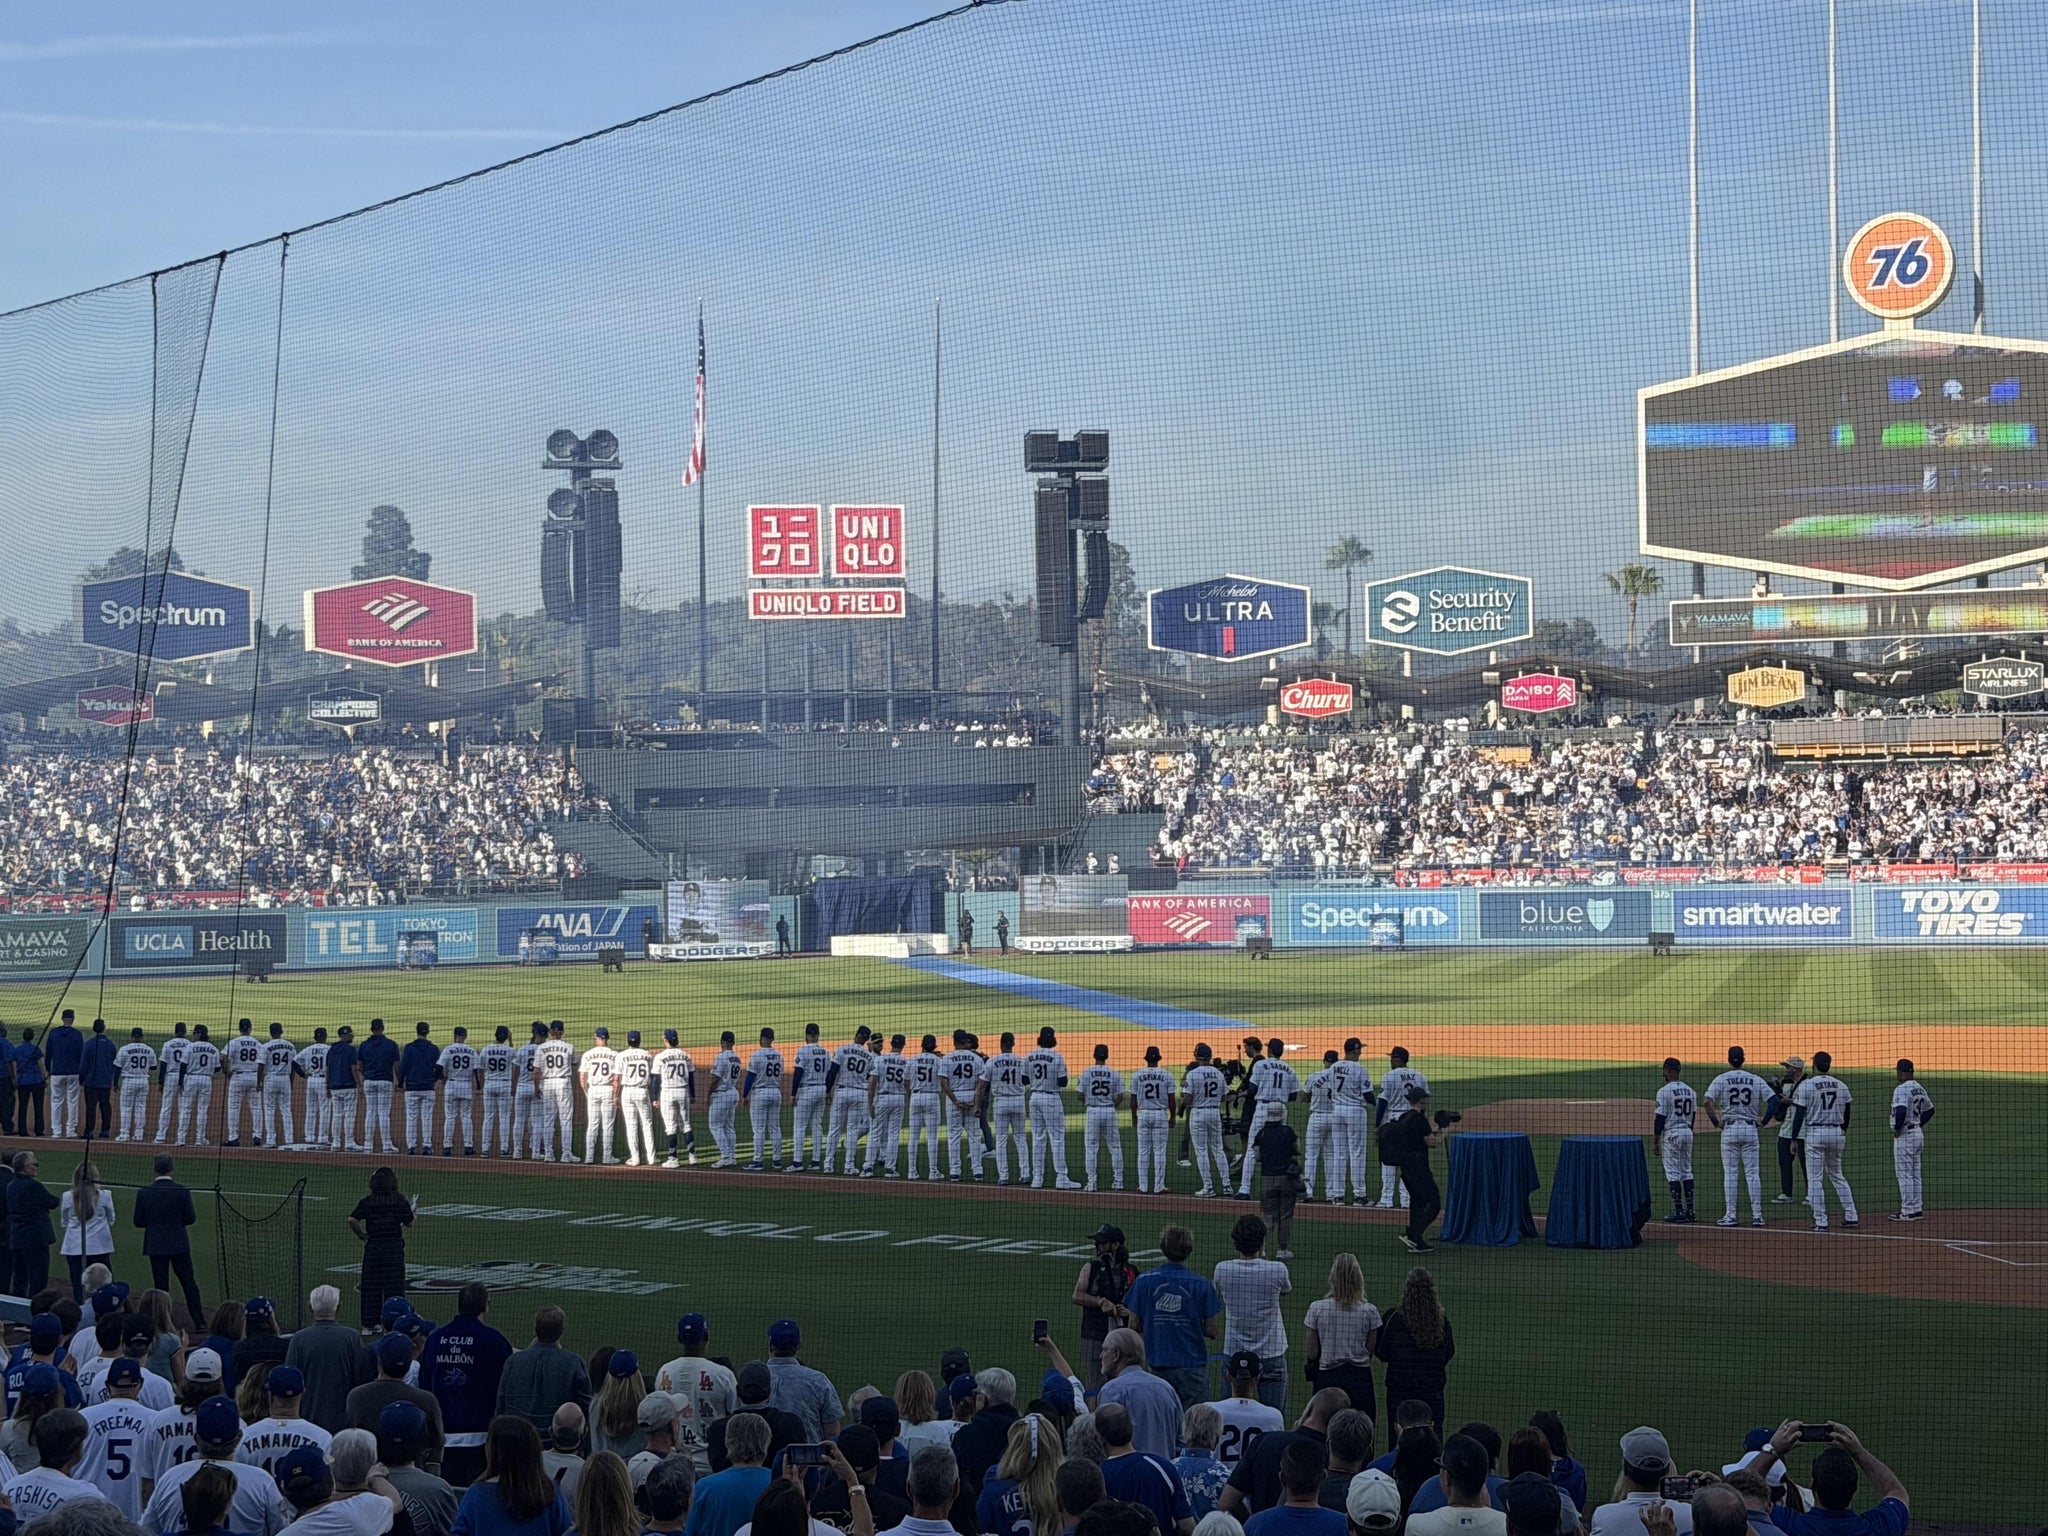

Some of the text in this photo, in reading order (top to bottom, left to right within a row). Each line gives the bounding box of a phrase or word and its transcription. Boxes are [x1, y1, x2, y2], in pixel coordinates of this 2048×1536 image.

[1868, 238, 1931, 289] 76
[842, 516, 890, 539] UNI
[843, 543, 895, 571] QLO
[759, 594, 897, 616] UNIQLO FIELD
[1429, 587, 1516, 612] Security
[99, 600, 226, 630] Spectrum
[1184, 601, 1275, 622] ULTRA
[347, 638, 443, 648] BANK OF AMERICA
[1968, 667, 2039, 679] STARLUX
[1506, 685, 1554, 696] DAISO
[1733, 671, 1798, 698] JIM BEAM
[1979, 679, 2030, 689] AIRLINES
[81, 699, 151, 712] Yakult
[311, 700, 379, 709] CHAMPIONS
[1283, 688, 1350, 709] Churu
[311, 709, 379, 718] COLLECTIVE
[1128, 897, 1161, 909] ANK
[1165, 898, 1183, 909] OF
[1186, 897, 1252, 909] AMERICA
[1654, 891, 1670, 899] 375
[1901, 889, 2001, 913] TOYO
[1301, 902, 1440, 934] Specm
[1520, 899, 1584, 924] blue
[1683, 903, 1842, 926] smartwater
[401, 917, 448, 931] TOKYO
[534, 913, 593, 937] ANA
[1917, 913, 2028, 936] TIRES
[134, 929, 273, 952] UCLA Health
[310, 919, 389, 955] TEL
[437, 931, 473, 943] TRON
[1030, 939, 1117, 949] DODGERS
[24, 947, 69, 958] CASINO
[581, 941, 592, 951] of
[593, 941, 625, 951] JAPAN
[675, 946, 761, 957] DODGERS
[130, 1055, 148, 1070] 90
[173, 1049, 182, 1063] 0
[199, 1053, 208, 1067] 0
[239, 1048, 258, 1062] 88
[272, 1051, 289, 1066] 84
[311, 1056, 324, 1071] 91
[452, 1055, 470, 1070] 89
[545, 1054, 564, 1069] 80
[488, 1057, 507, 1072] 96
[591, 1062, 611, 1077] 78
[628, 1063, 647, 1079] 76
[667, 1063, 687, 1079] 70
[765, 1062, 781, 1078] 66
[814, 1057, 826, 1074] 61
[847, 1056, 866, 1074] 60
[952, 1063, 973, 1079] 49
[1034, 1063, 1048, 1080] 31
[885, 1066, 904, 1084] 59
[917, 1066, 933, 1083] 51
[1001, 1068, 1017, 1085] 41
[1273, 1071, 1284, 1089] 11
[1726, 1077, 1755, 1086] TUCKER
[1090, 1079, 1111, 1097] 25
[1144, 1082, 1161, 1100] 21
[1204, 1081, 1218, 1098] 12
[1335, 1076, 1346, 1093] 7
[1672, 1088, 1691, 1097] BETTS
[1728, 1087, 1752, 1106] 23
[1820, 1091, 1837, 1111] 17
[1674, 1098, 1692, 1117] 50
[449, 1336, 475, 1345] CLUB
[450, 1345, 461, 1354] du
[9, 1373, 25, 1390] RO
[699, 1371, 714, 1391] LA
[157, 1422, 197, 1441] YAMA
[682, 1425, 697, 1445] LA
[106, 1438, 133, 1481] 5
[1001, 1492, 1024, 1515] KE
